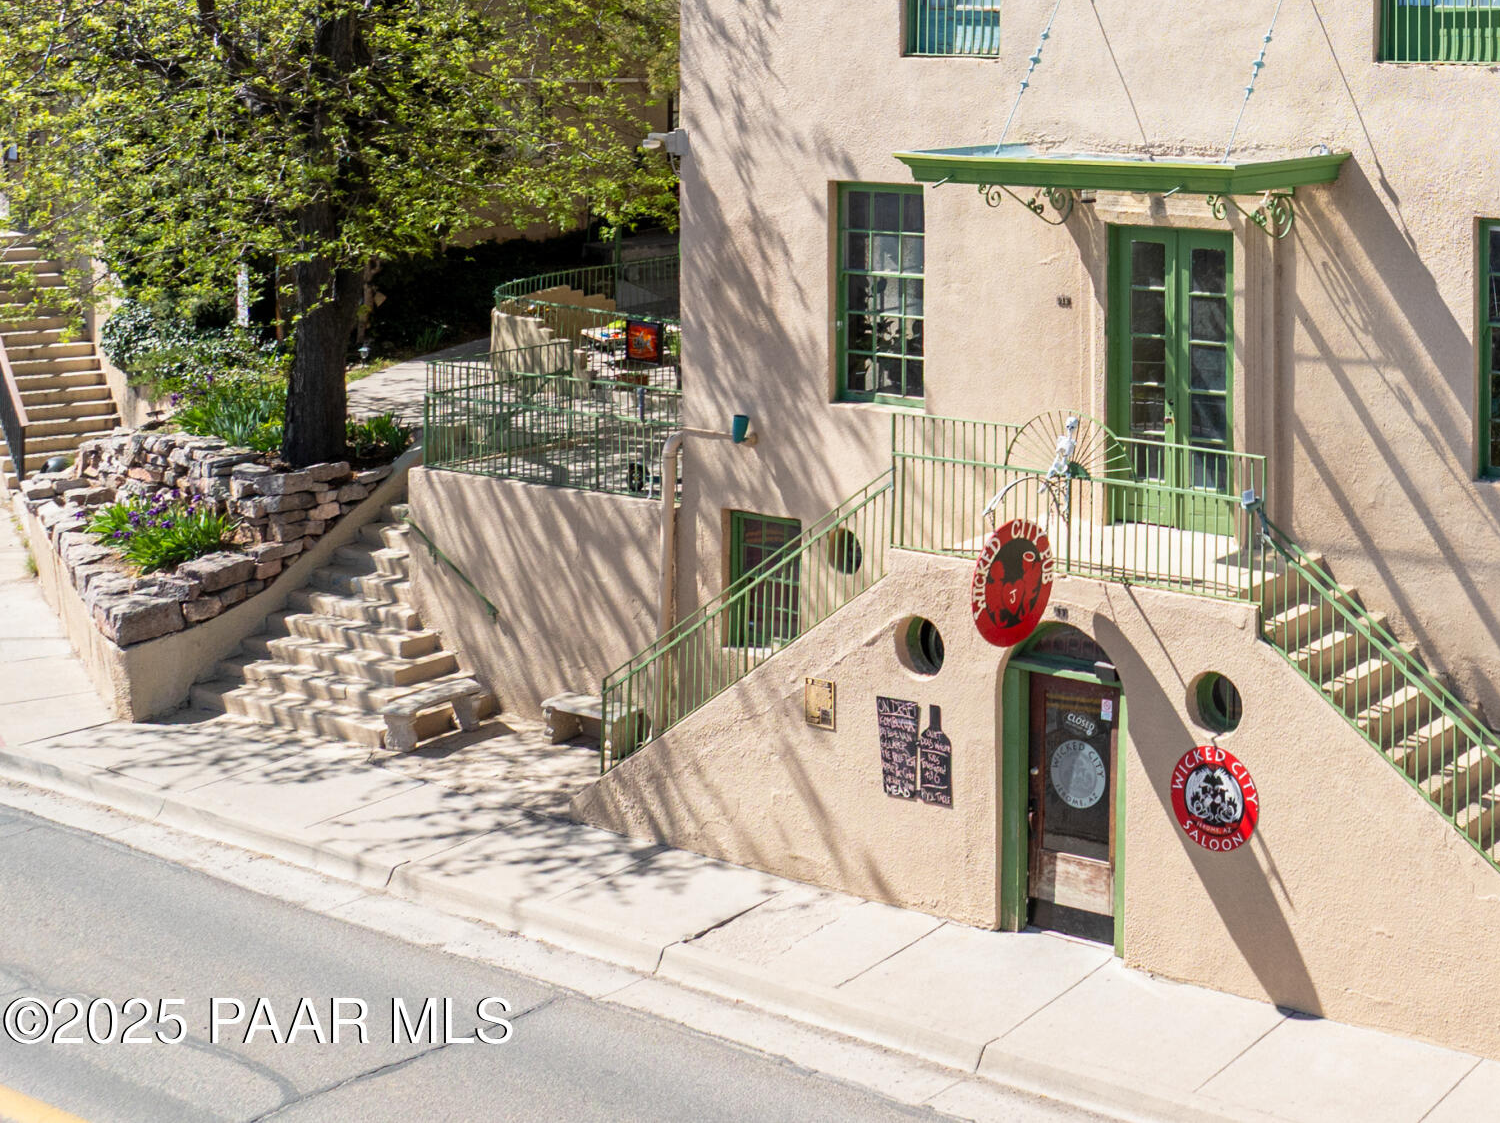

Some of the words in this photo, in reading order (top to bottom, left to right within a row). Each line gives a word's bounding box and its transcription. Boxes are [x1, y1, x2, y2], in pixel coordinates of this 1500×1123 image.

[974, 538, 1001, 620] WICKED
[1011, 519, 1046, 546] CITY
[1040, 546, 1053, 585] PUB
[1067, 713, 1095, 731] CLOSED
[1053, 741, 1085, 769] WICKED
[1088, 750, 1105, 779] CITY
[1172, 746, 1225, 789] WICKED
[1231, 762, 1258, 805] CITY
[886, 784, 911, 798] MEAD
[1183, 820, 1244, 851] SALOON
